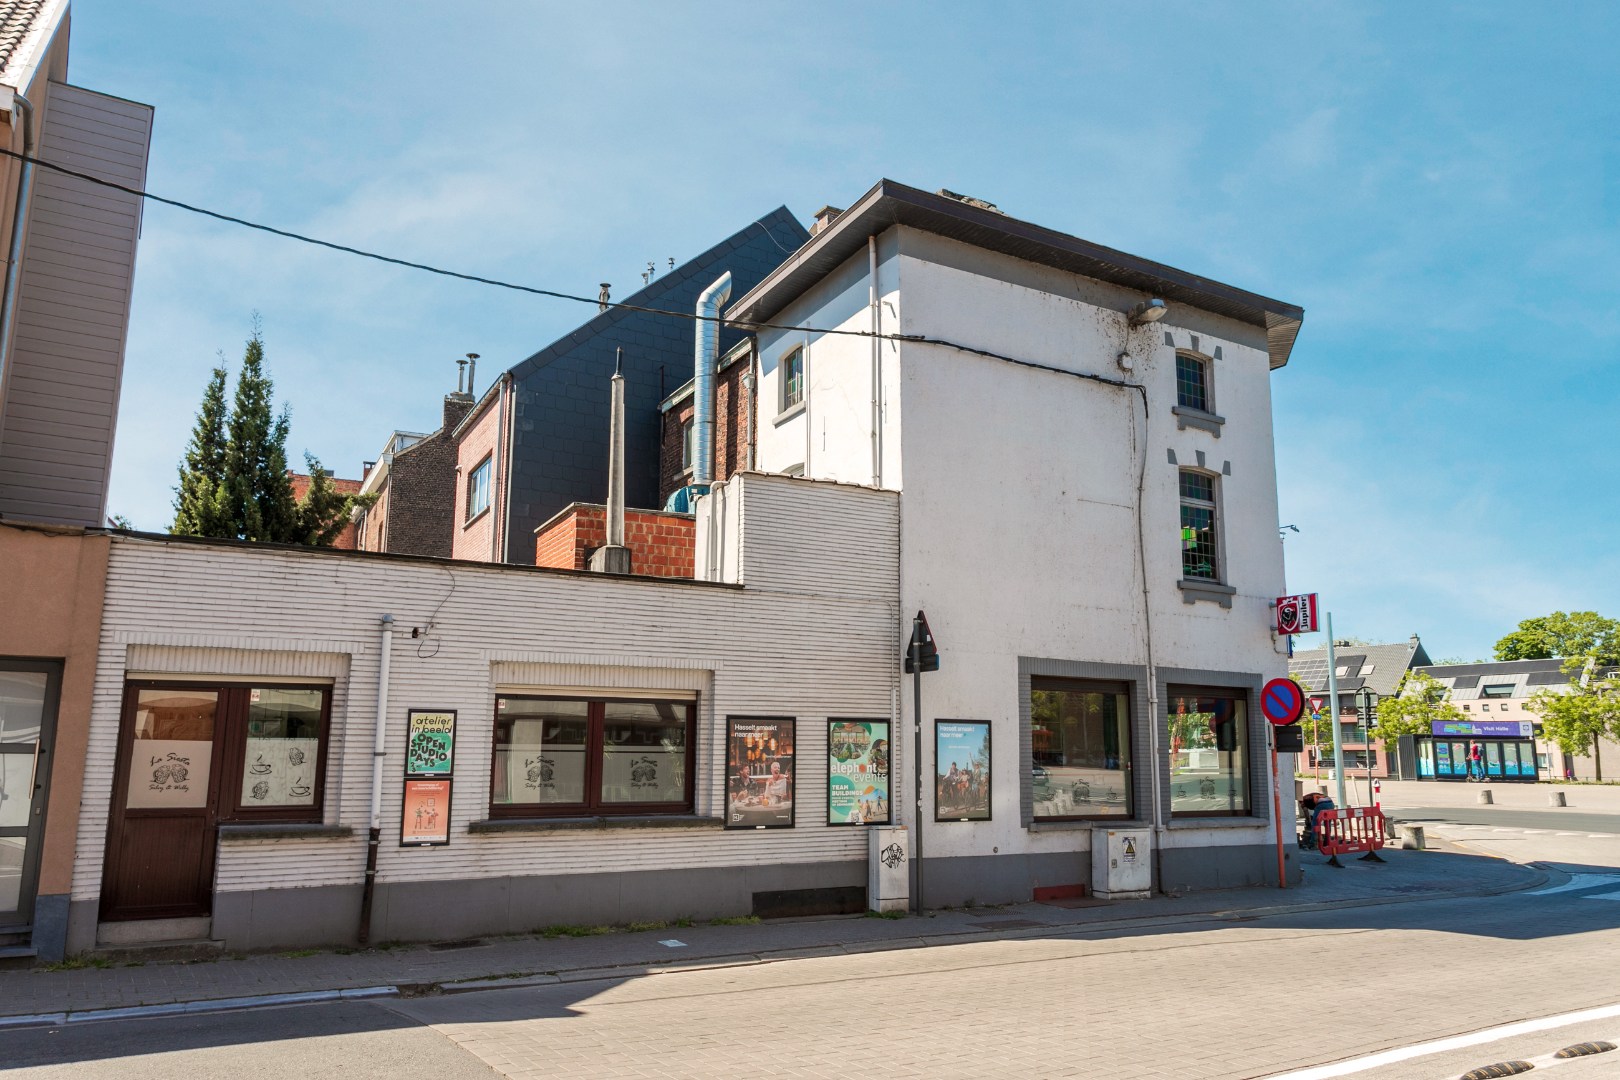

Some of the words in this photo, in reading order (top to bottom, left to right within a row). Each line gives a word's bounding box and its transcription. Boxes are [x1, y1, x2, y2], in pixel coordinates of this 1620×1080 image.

[1300, 596, 1310, 629] Jupiler
[416, 716, 452, 725] atelier
[421, 724, 453, 734] beeld
[417, 733, 446, 751] OPEN
[410, 748, 436, 768] DAYS
[411, 739, 448, 762] STUDIO
[150, 756, 163, 767] La
[166, 752, 190, 766] Siesta
[853, 772, 888, 783] events
